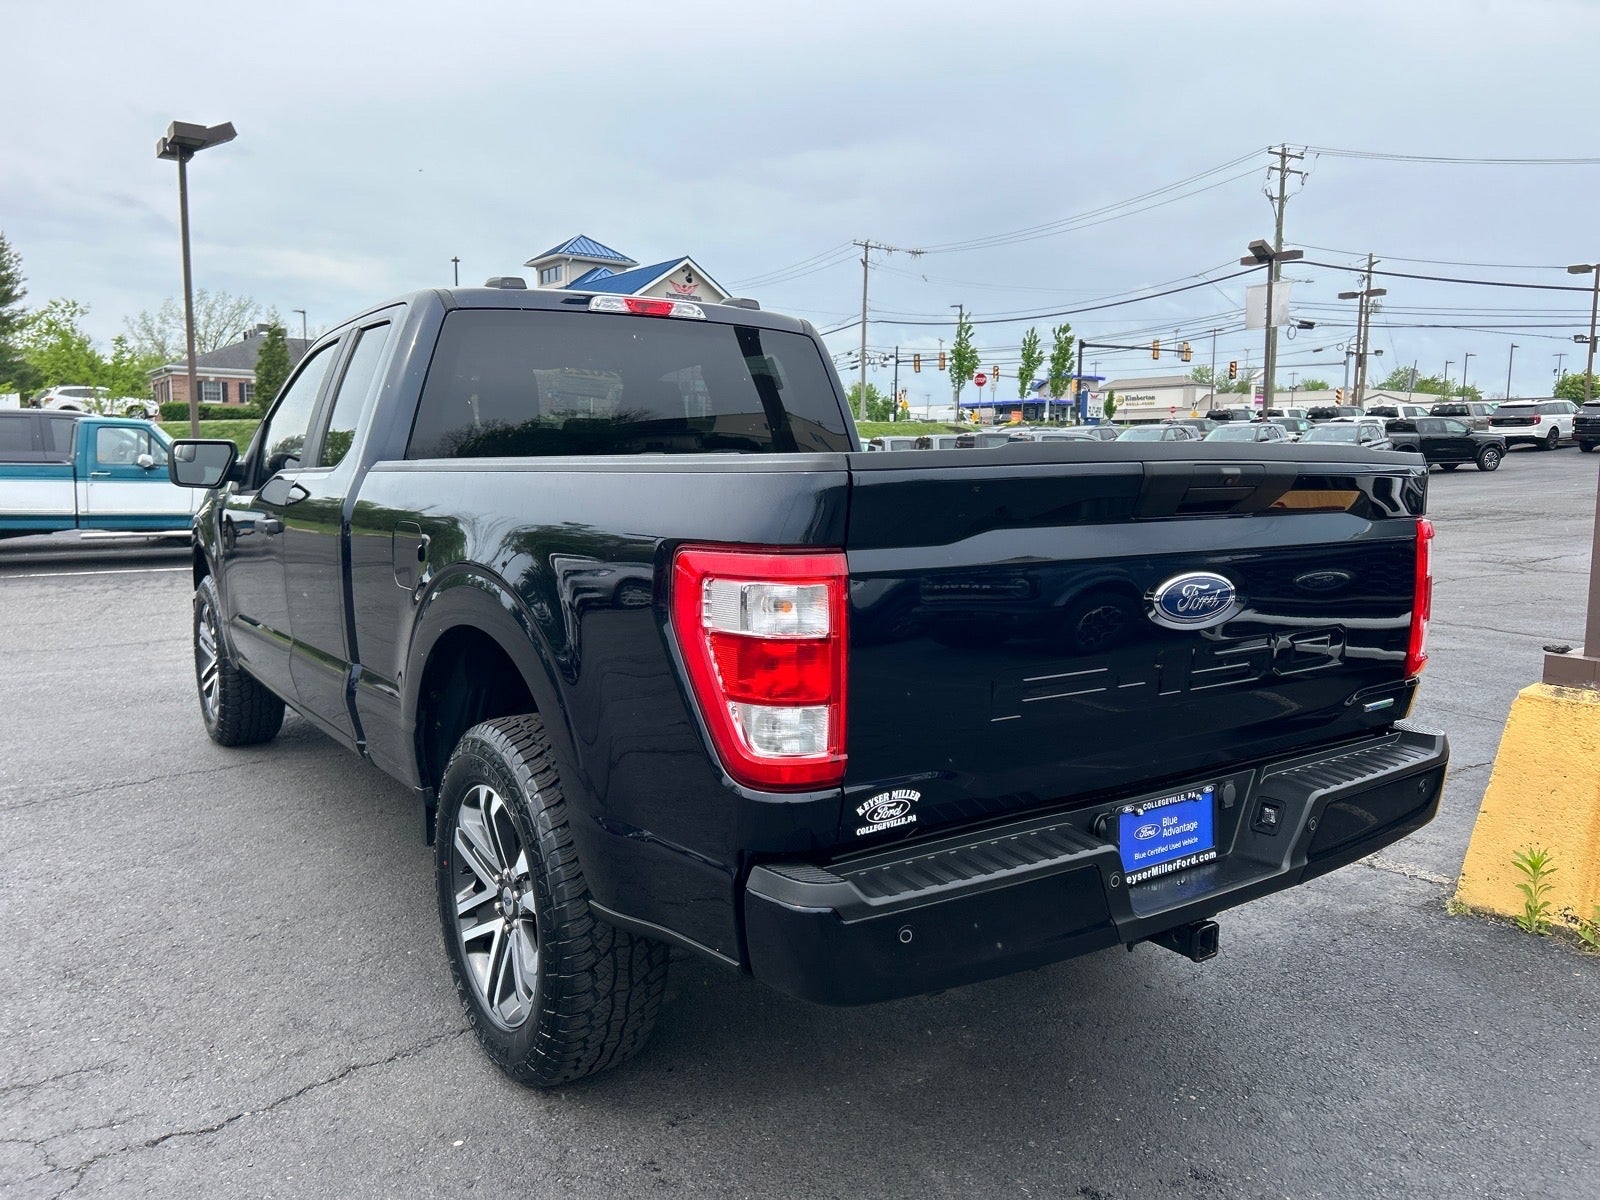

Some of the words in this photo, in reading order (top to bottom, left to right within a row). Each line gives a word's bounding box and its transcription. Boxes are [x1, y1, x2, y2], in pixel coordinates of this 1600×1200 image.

[1177, 584, 1220, 612] Ford
[856, 792, 890, 816] KEYSER
[891, 789, 921, 802] MILLER
[1187, 792, 1196, 800] PA
[873, 802, 903, 820] Ford
[1162, 815, 1178, 827] Blue
[1162, 820, 1198, 838] Advantage
[1139, 826, 1157, 838] Ford
[1134, 852, 1147, 860] Blue
[1147, 845, 1168, 857] Certified
[1169, 842, 1182, 851] Used
[1182, 836, 1198, 847] Vehicle
[1126, 850, 1217, 885] eyserMillerFord.com
